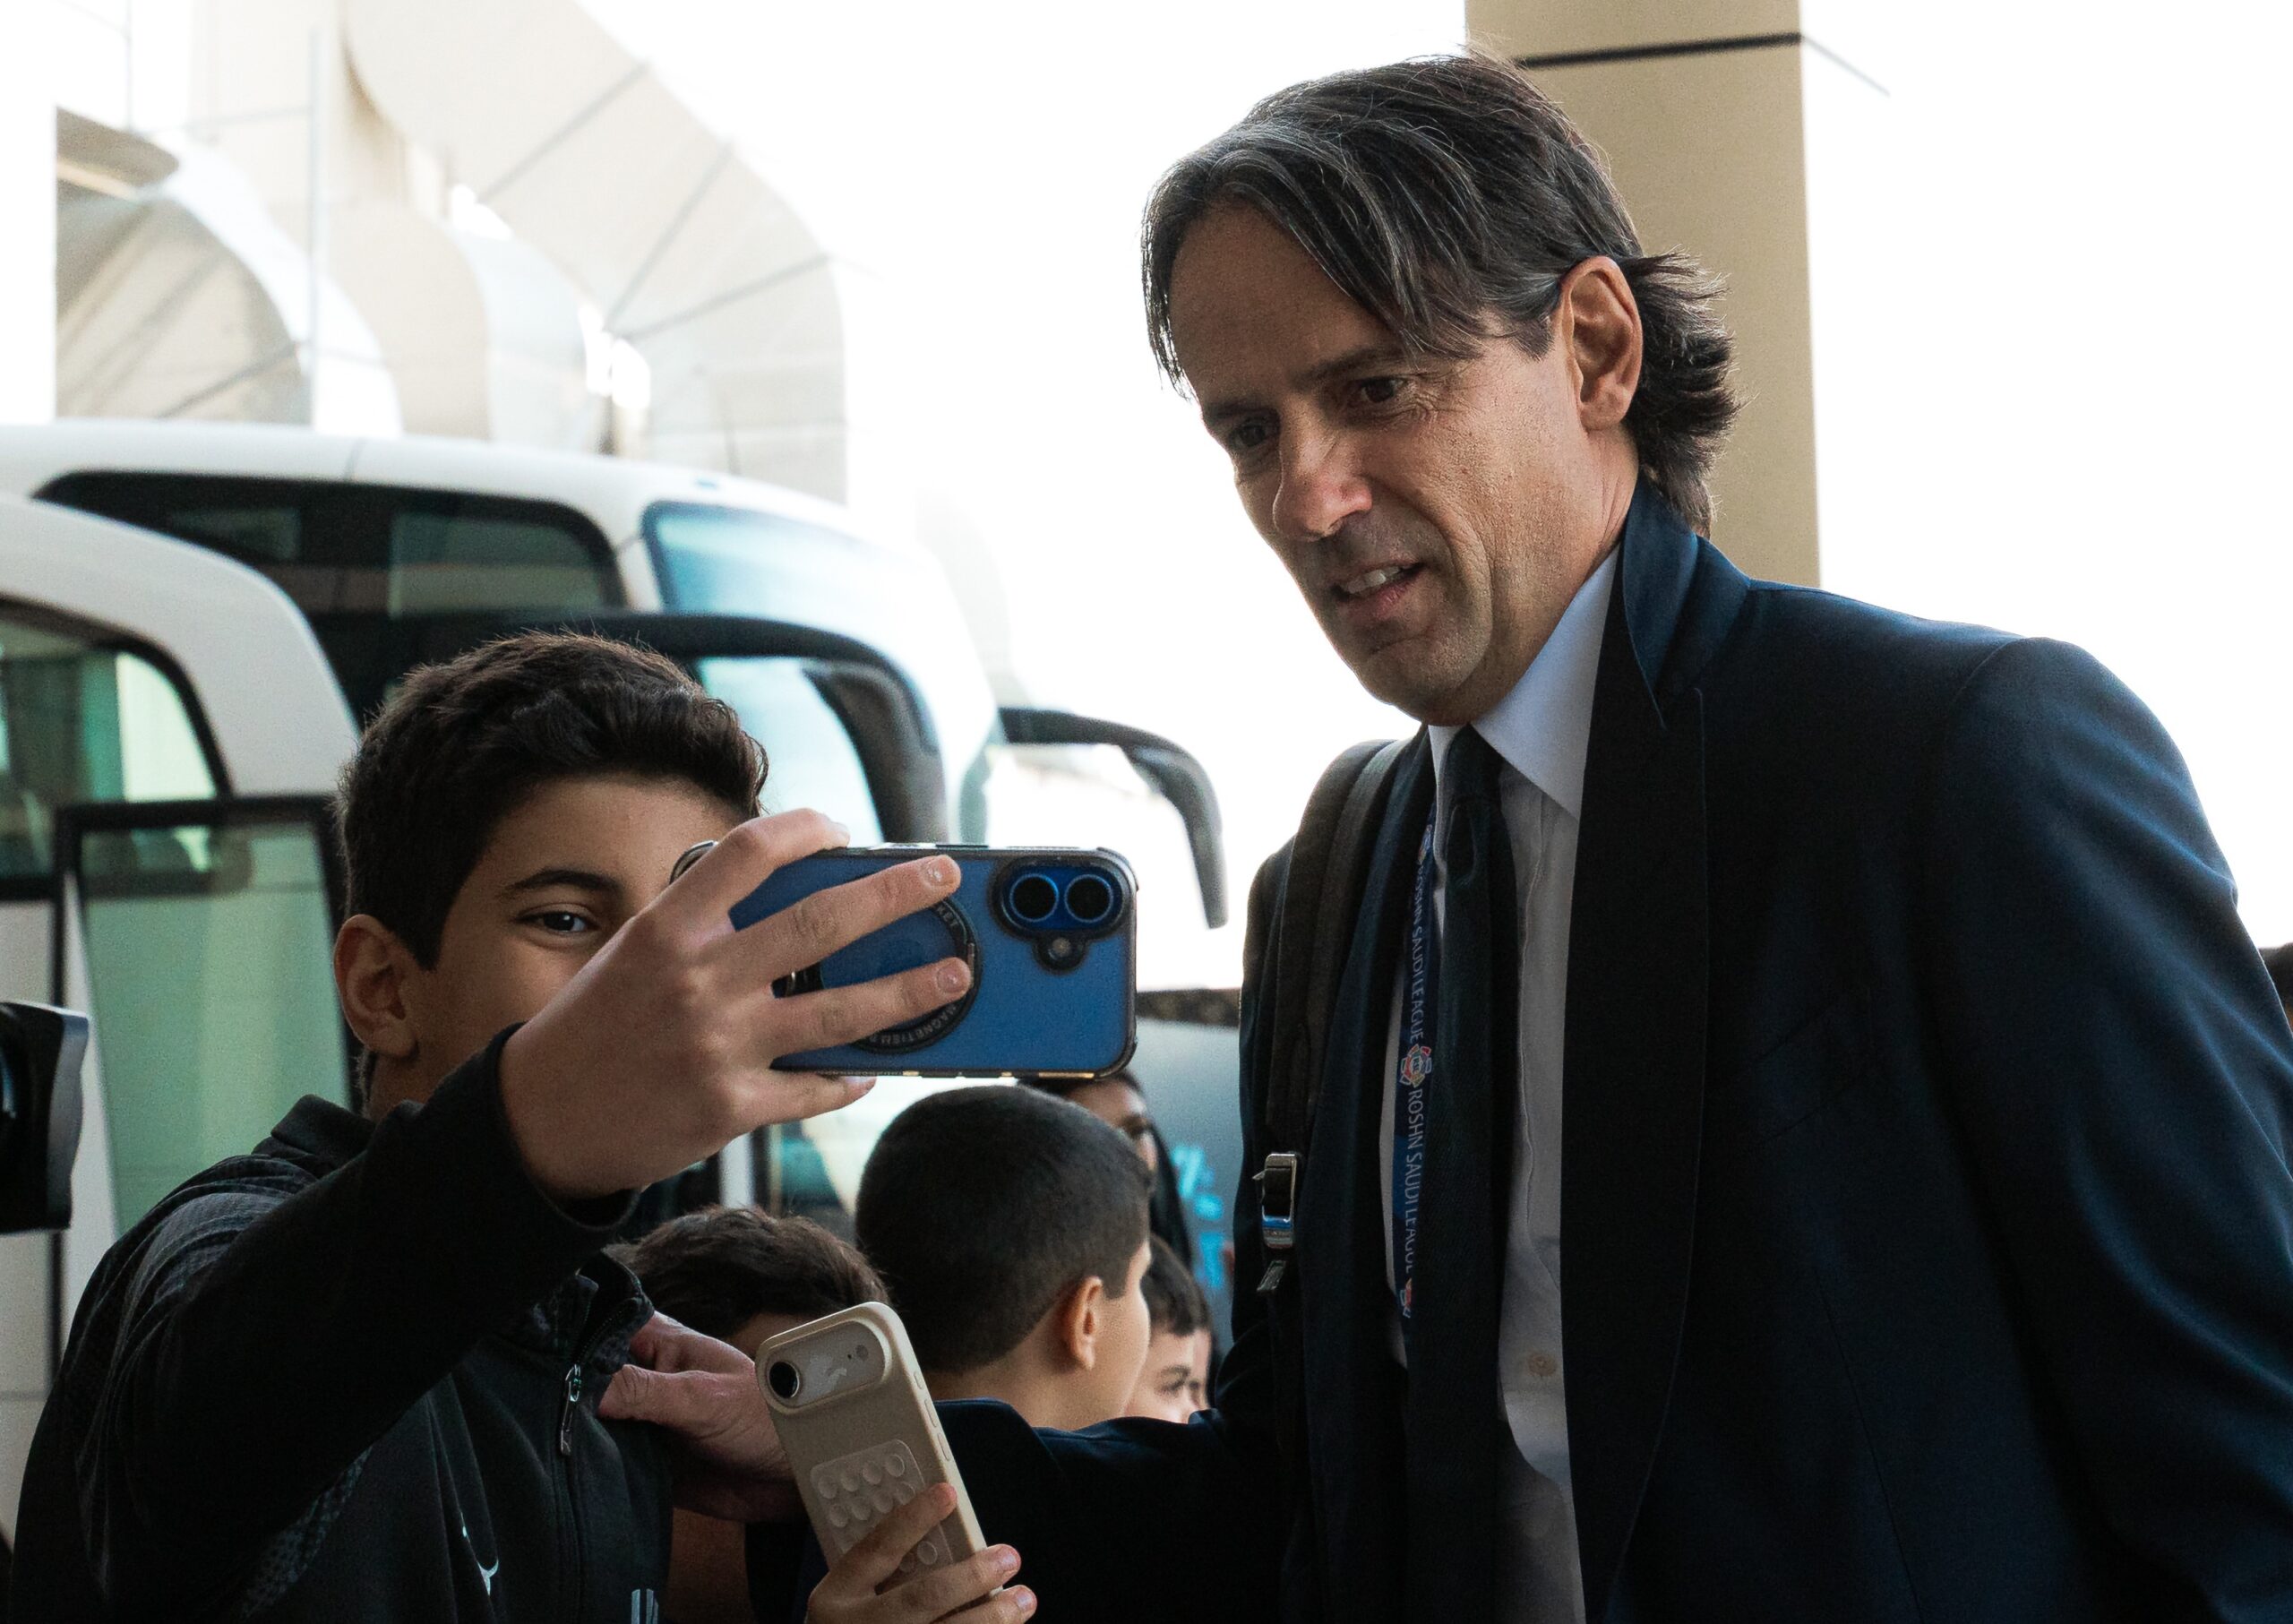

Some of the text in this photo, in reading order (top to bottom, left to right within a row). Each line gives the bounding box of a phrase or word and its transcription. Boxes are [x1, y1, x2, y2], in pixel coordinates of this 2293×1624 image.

[937, 905, 960, 928] KET
[1412, 926, 1424, 978] SAUDI
[1410, 980, 1424, 1044] LEAGUE
[1406, 1089, 1424, 1149] ROSHN
[1404, 1153, 1423, 1206] SAUDI
